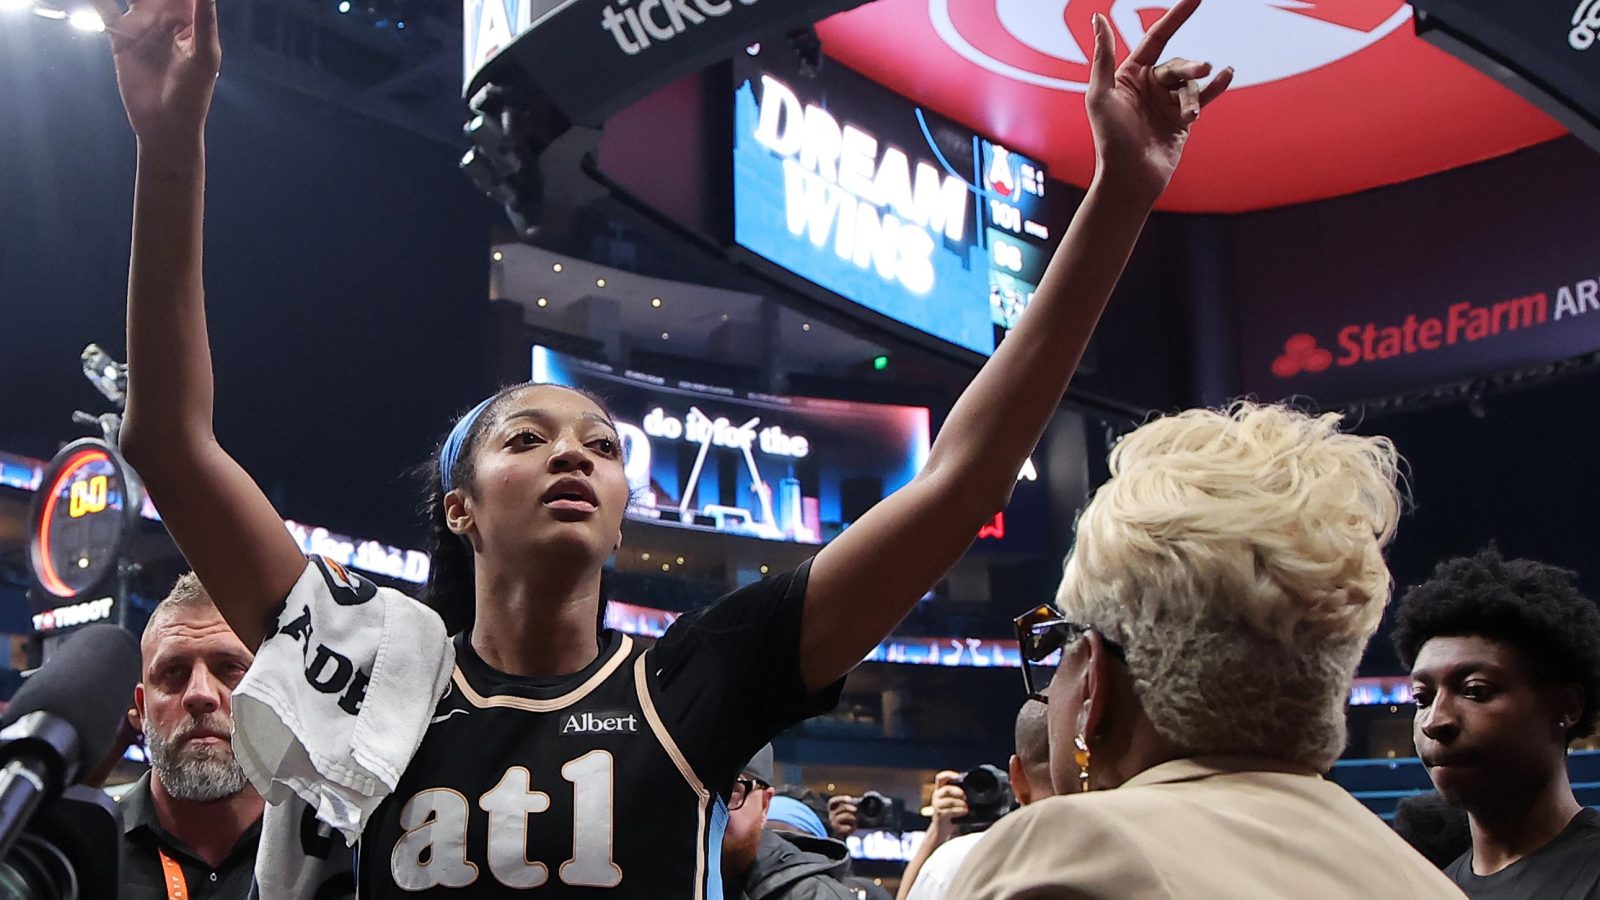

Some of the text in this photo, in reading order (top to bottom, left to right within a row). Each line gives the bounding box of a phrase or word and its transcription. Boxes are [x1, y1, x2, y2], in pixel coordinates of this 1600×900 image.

[754, 74, 968, 241] DREAM
[782, 159, 934, 293] WINS
[1553, 277, 1600, 321] AR
[643, 407, 682, 439] do
[712, 417, 757, 448] for
[759, 425, 809, 458] the
[562, 712, 638, 734] Albert
